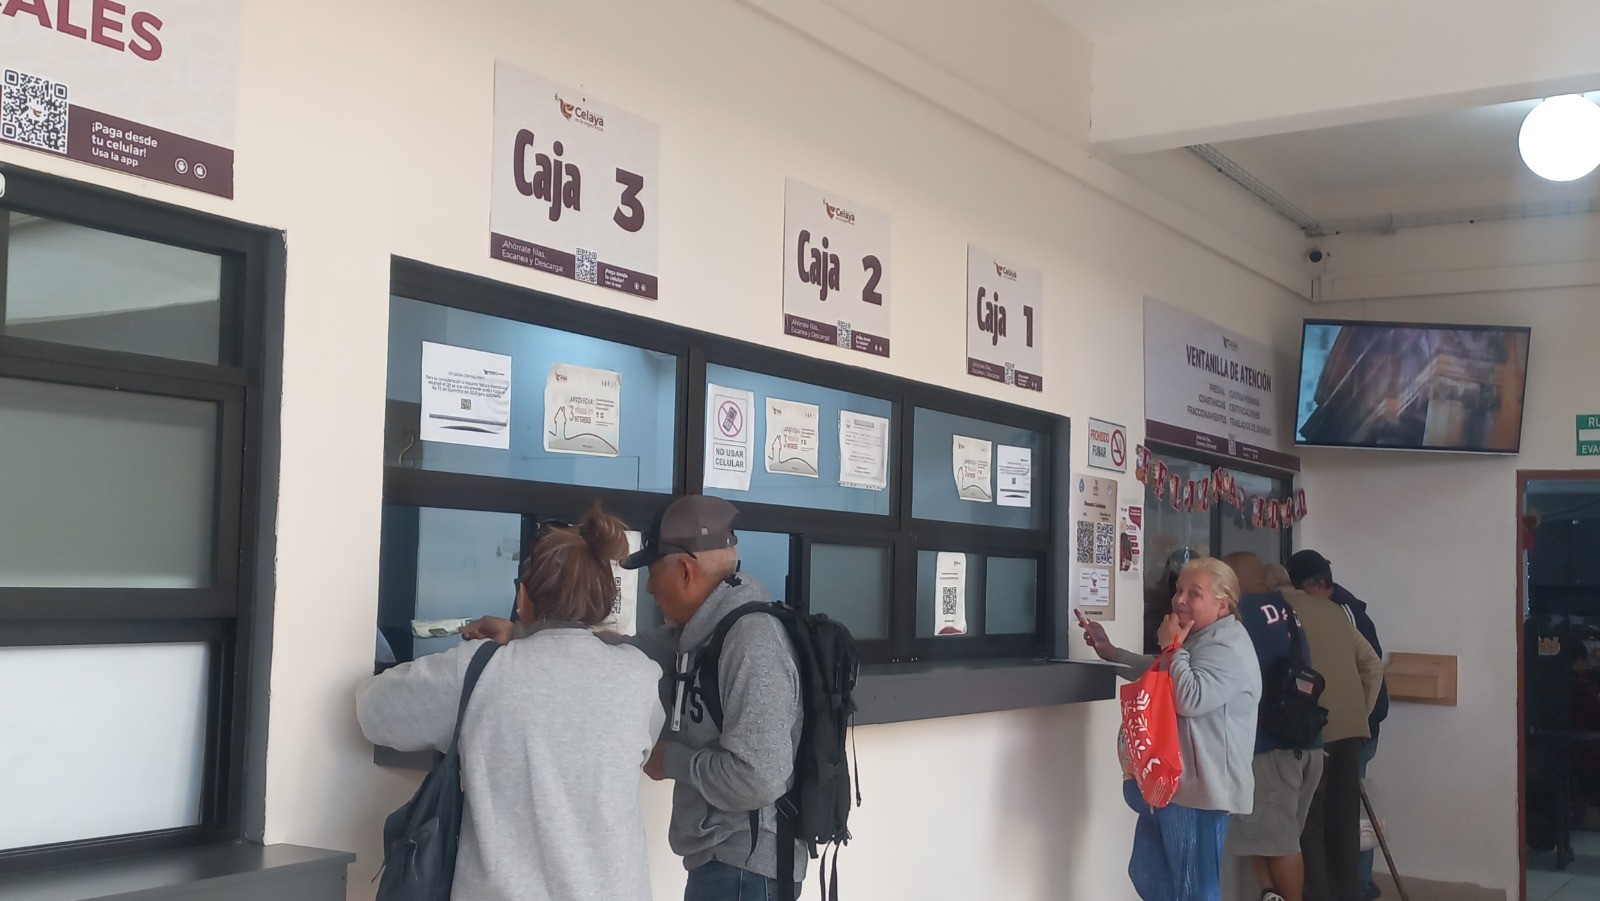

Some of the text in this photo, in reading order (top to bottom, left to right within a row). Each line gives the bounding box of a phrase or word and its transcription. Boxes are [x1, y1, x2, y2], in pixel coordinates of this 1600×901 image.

[0, 0, 163, 61] ALES
[575, 107, 604, 126] Celaya
[91, 122, 158, 148] ¡Paga desde
[91, 135, 147, 157] tu celular!
[92, 148, 139, 167] Usa la app
[513, 128, 645, 232] Caja 3
[836, 208, 855, 222] Celaya
[502, 250, 528, 263] Escanea
[797, 230, 882, 306] Caja 2
[977, 287, 1033, 348] Caja 1
[1186, 344, 1271, 392] VENTANILLA DE ATENCIÓN
[1588, 417, 1600, 427] RU
[716, 447, 744, 458] NO USAR
[1582, 444, 1600, 454] EVA
[715, 458, 744, 468] CELULAR
